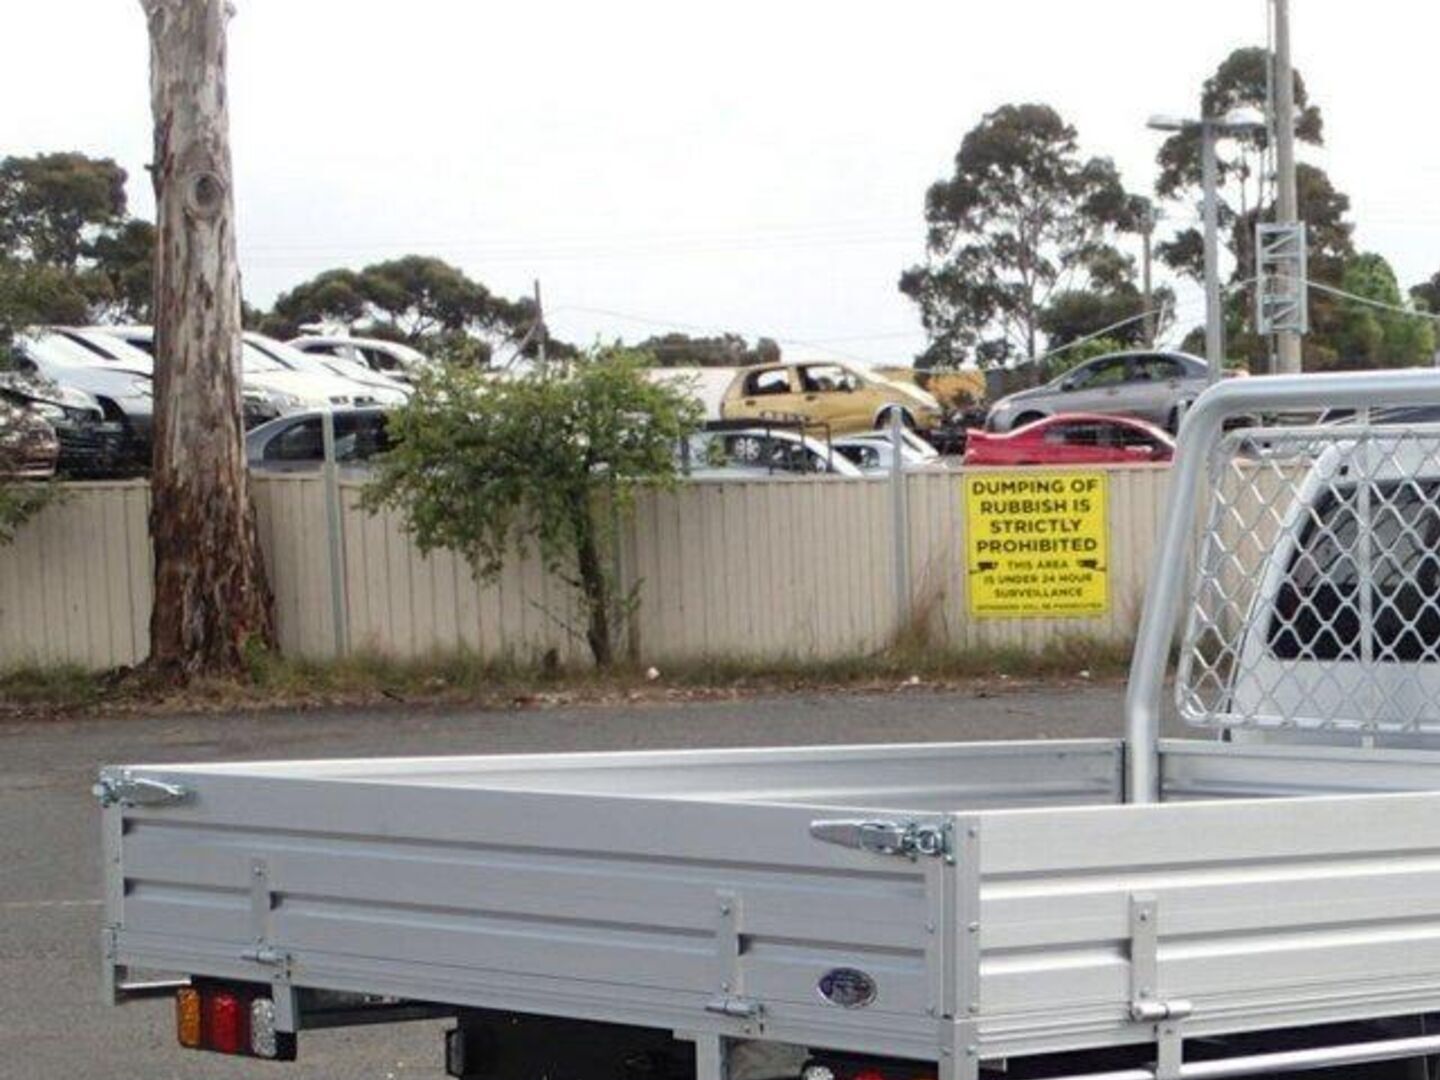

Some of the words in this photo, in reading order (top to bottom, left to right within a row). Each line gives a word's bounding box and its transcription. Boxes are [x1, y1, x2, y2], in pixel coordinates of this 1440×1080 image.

[972, 479, 1065, 495] DUMPING
[1070, 478, 1099, 493] OF
[980, 500, 1068, 515] RUBBISH
[1072, 499, 1091, 513] IS
[990, 519, 1082, 534] STRICTLY
[976, 537, 1097, 553] PROHIBITED
[1007, 560, 1034, 571] THIS
[1037, 560, 1069, 570] AREA
[983, 575, 995, 585] IS
[998, 574, 1037, 585] UNDER
[1041, 574, 1056, 583] 24
[1058, 573, 1093, 583] HOUR
[994, 587, 1083, 598] SURVEILLANCE
